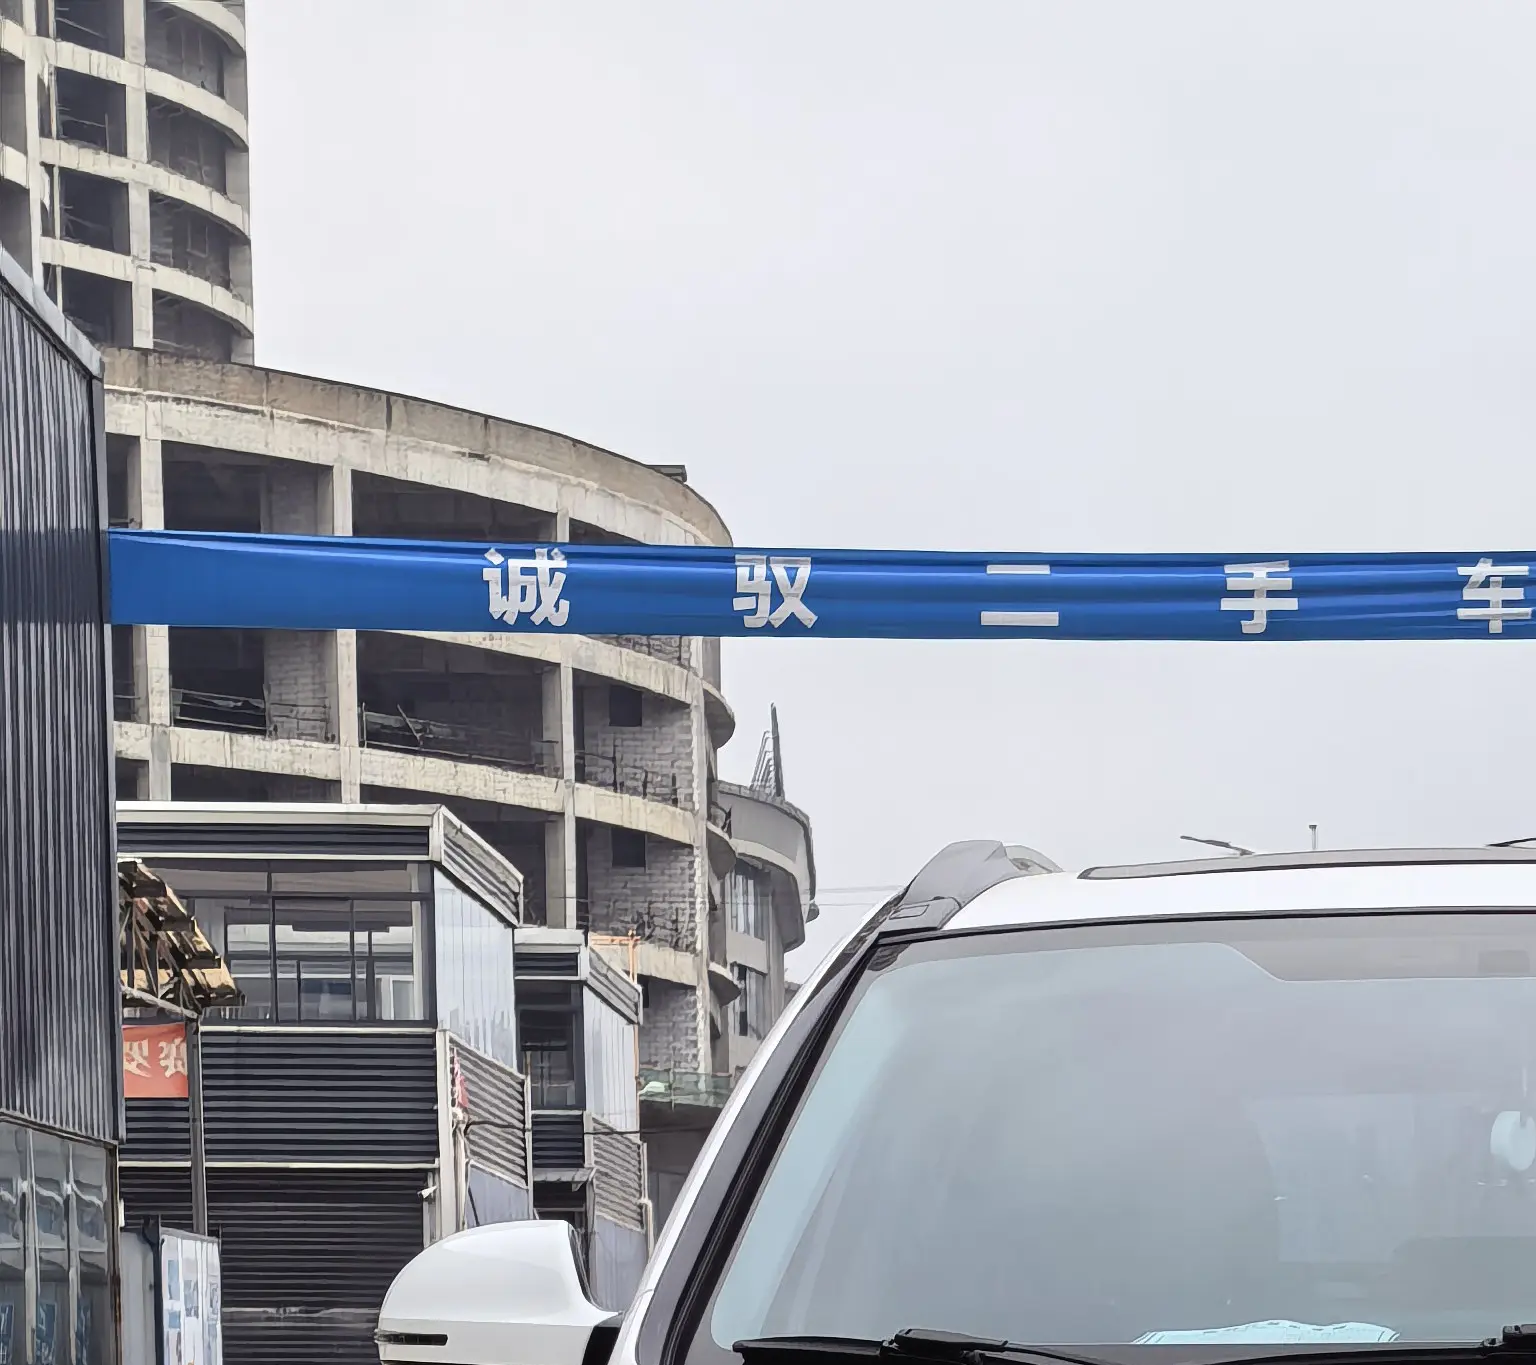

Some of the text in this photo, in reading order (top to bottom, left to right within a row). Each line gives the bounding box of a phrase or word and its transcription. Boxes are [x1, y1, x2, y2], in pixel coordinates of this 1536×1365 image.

[482, 547, 1532, 634] 诚驭二手车
